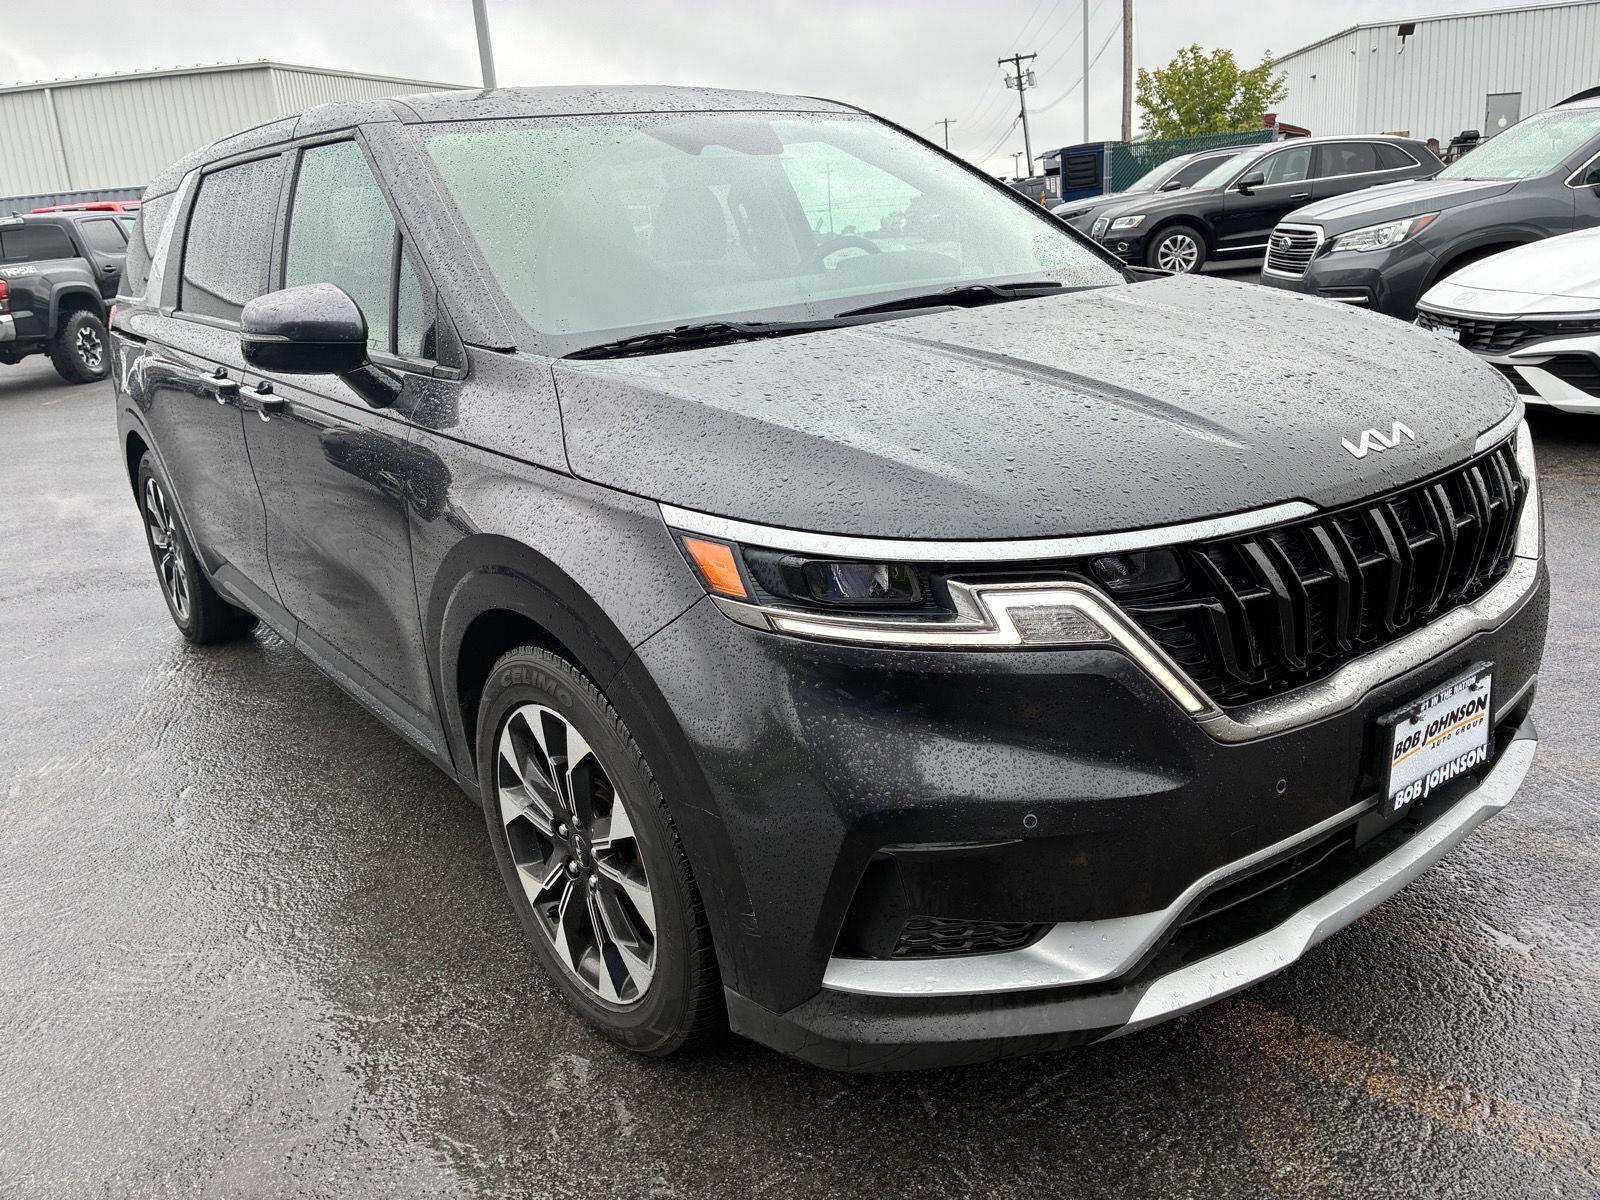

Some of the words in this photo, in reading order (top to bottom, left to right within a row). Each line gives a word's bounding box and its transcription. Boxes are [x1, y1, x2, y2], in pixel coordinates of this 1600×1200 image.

[1341, 421, 1415, 459] KIA
[501, 667, 573, 708] CELIMO
[1430, 695, 1439, 707] IN
[1440, 687, 1453, 701] THE
[1453, 675, 1477, 695] NATION
[1393, 729, 1422, 761] BOB
[1422, 693, 1488, 747] JOHNSON
[1431, 733, 1452, 750] AUTO
[1455, 717, 1484, 736] GROUP
[1394, 779, 1422, 811] BOB
[1423, 744, 1488, 798] JOHNSON
